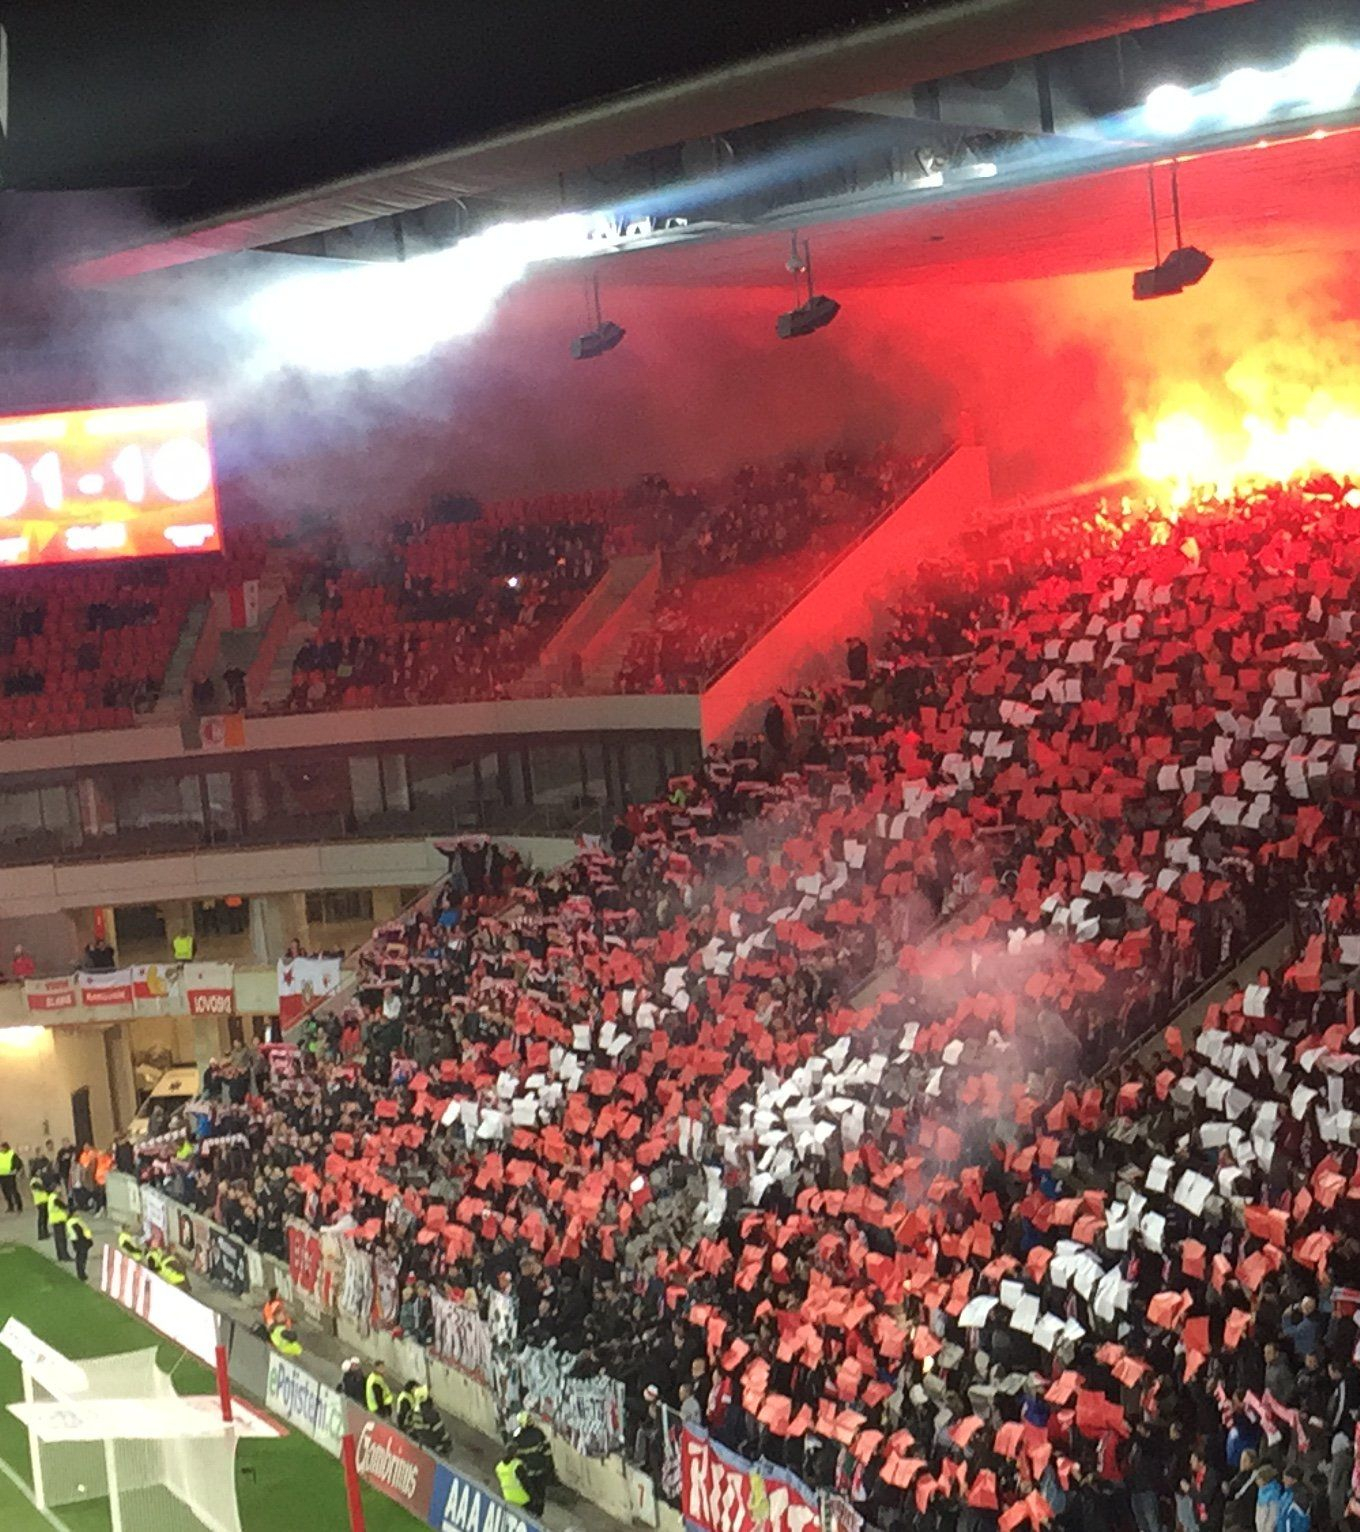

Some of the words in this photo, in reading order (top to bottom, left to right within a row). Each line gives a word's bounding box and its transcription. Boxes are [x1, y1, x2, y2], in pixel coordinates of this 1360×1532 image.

[356, 1421, 418, 1500] Gambrinus
[444, 1476, 480, 1532] AAA
[481, 1500, 528, 1532] AUT
